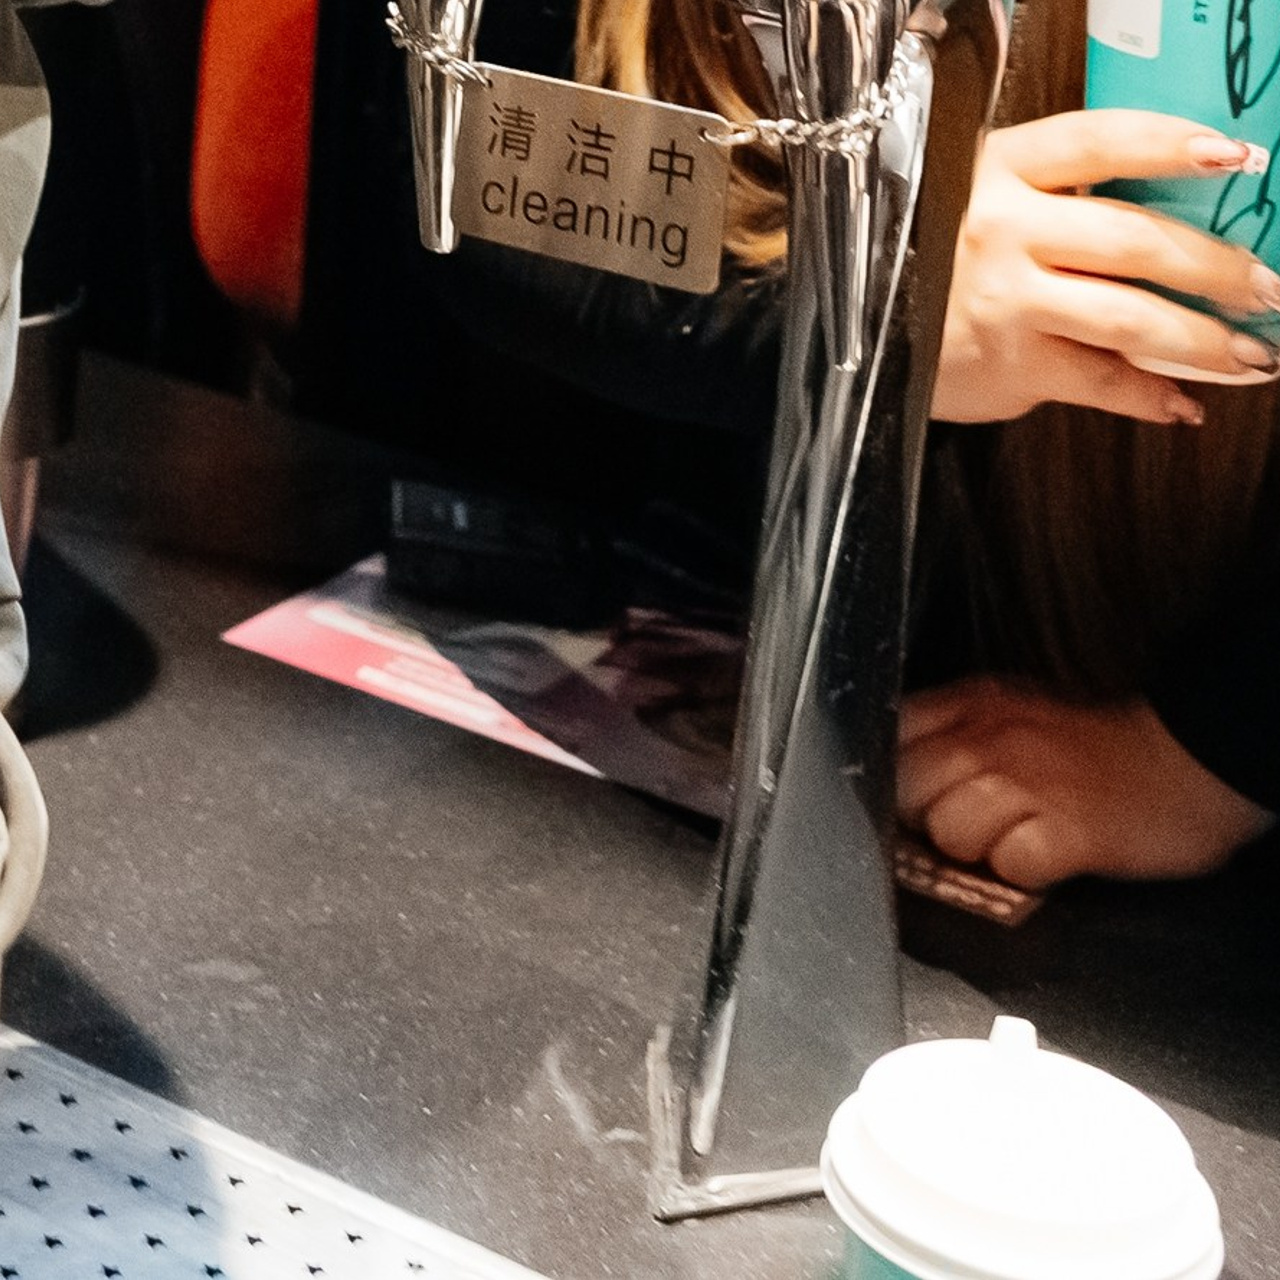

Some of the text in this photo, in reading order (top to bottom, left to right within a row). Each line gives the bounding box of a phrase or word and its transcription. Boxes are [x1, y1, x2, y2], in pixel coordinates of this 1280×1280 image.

[487, 101, 695, 196] 清洁中
[480, 175, 689, 268] cleaning
